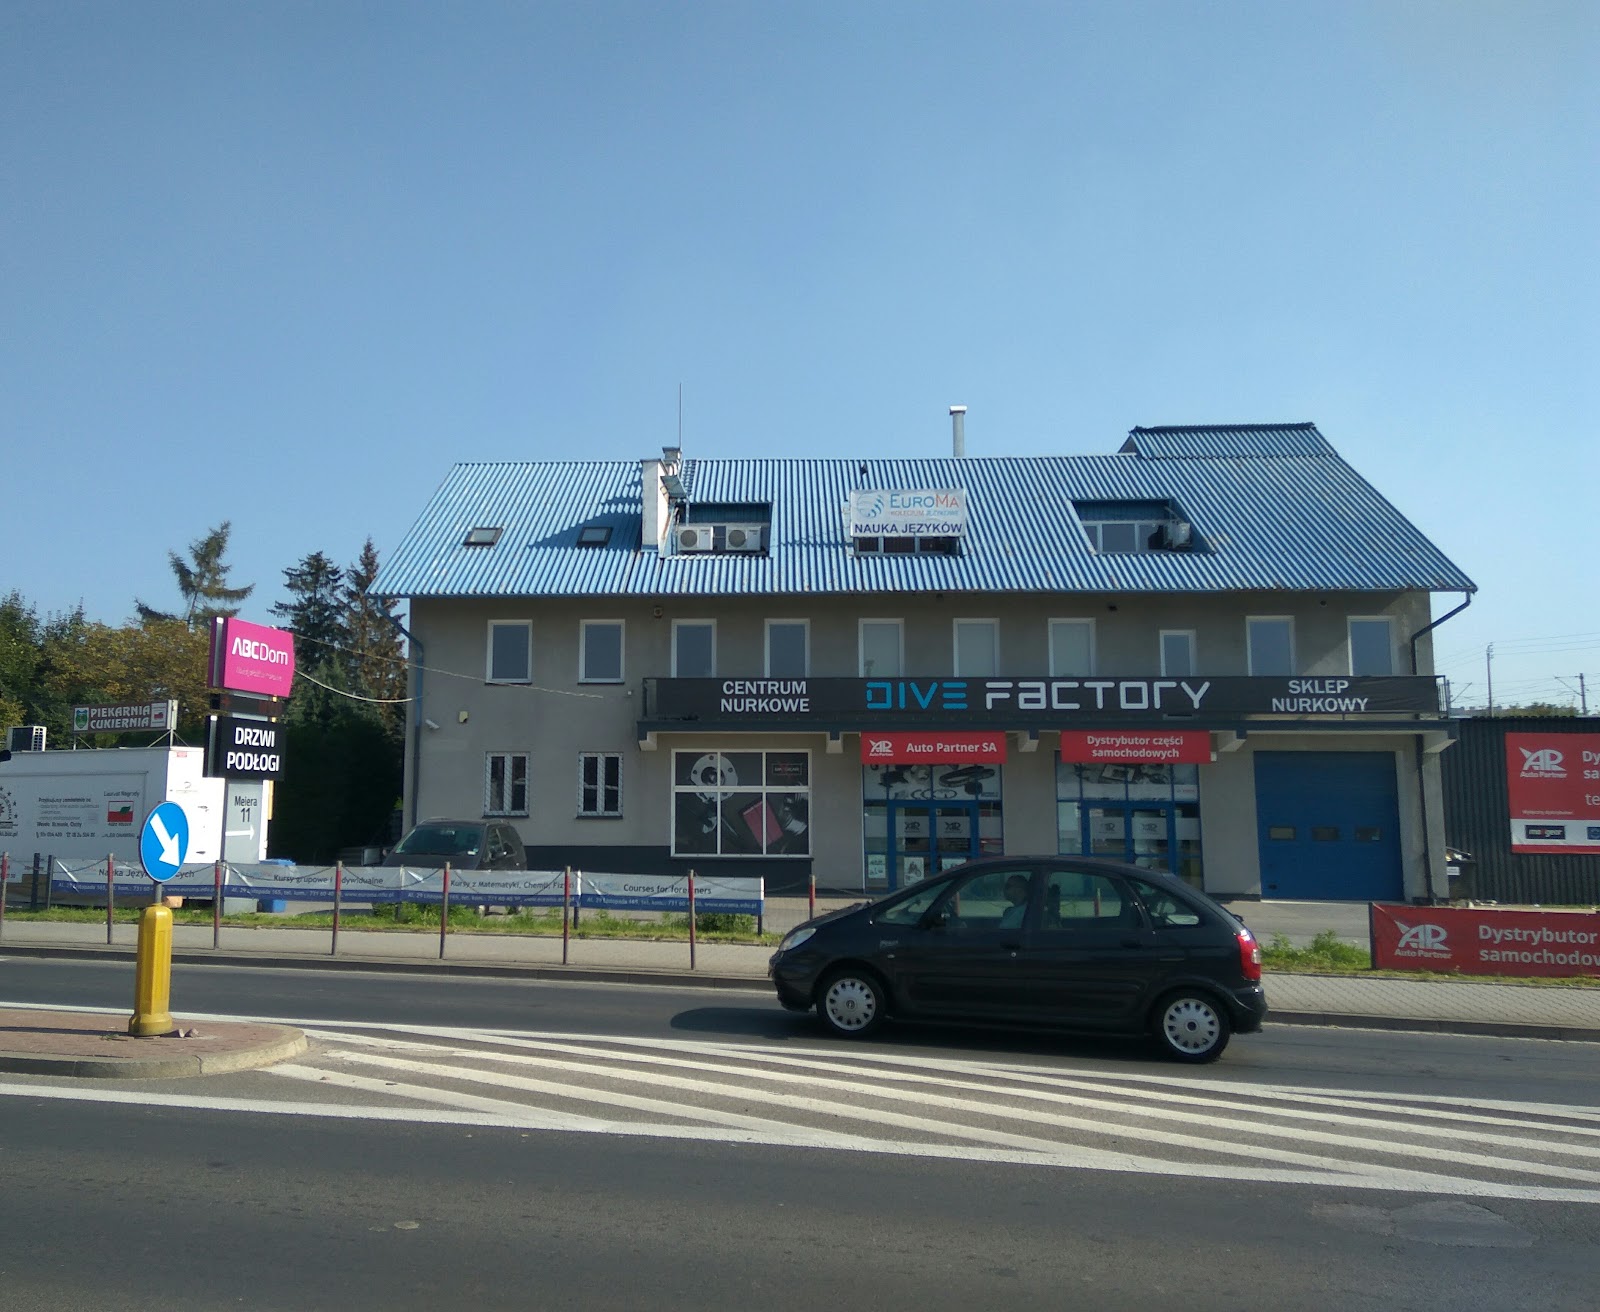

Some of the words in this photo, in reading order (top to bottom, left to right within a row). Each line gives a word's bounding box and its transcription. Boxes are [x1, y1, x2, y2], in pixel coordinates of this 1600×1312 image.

[855, 523, 899, 533] NAUKA
[901, 521, 963, 535] JĘZYKÓW
[231, 636, 288, 666] ABCDom
[722, 681, 807, 695] CENTRUM
[1288, 680, 1349, 694] SKLEP
[866, 682, 968, 710] DIVE
[90, 705, 151, 718] PIEKARNIA
[720, 698, 810, 713] NURKOWE
[1272, 697, 1368, 713] NURKOWY
[90, 717, 150, 729] CUKIERNIA
[234, 727, 276, 748] DRZWI
[1087, 735, 1150, 747] Dystrybutor
[1152, 735, 1184, 747] części
[906, 742, 934, 752] Auto
[936, 742, 980, 753] Partner
[982, 742, 997, 752] SA
[1092, 748, 1180, 760] samochodowych
[226, 752, 280, 772] PODŁOGI
[234, 796, 258, 807] Meiera
[240, 808, 252, 823] 11
[98, 869, 124, 878] Naka
[274, 875, 295, 884] Kursy
[450, 879, 471, 888] Kursy
[623, 883, 655, 893] Courses
[656, 884, 670, 893] for
[670, 884, 712, 895] foreners
[1479, 924, 1598, 946] Dystrybutor
[1394, 949, 1418, 957] Auto
